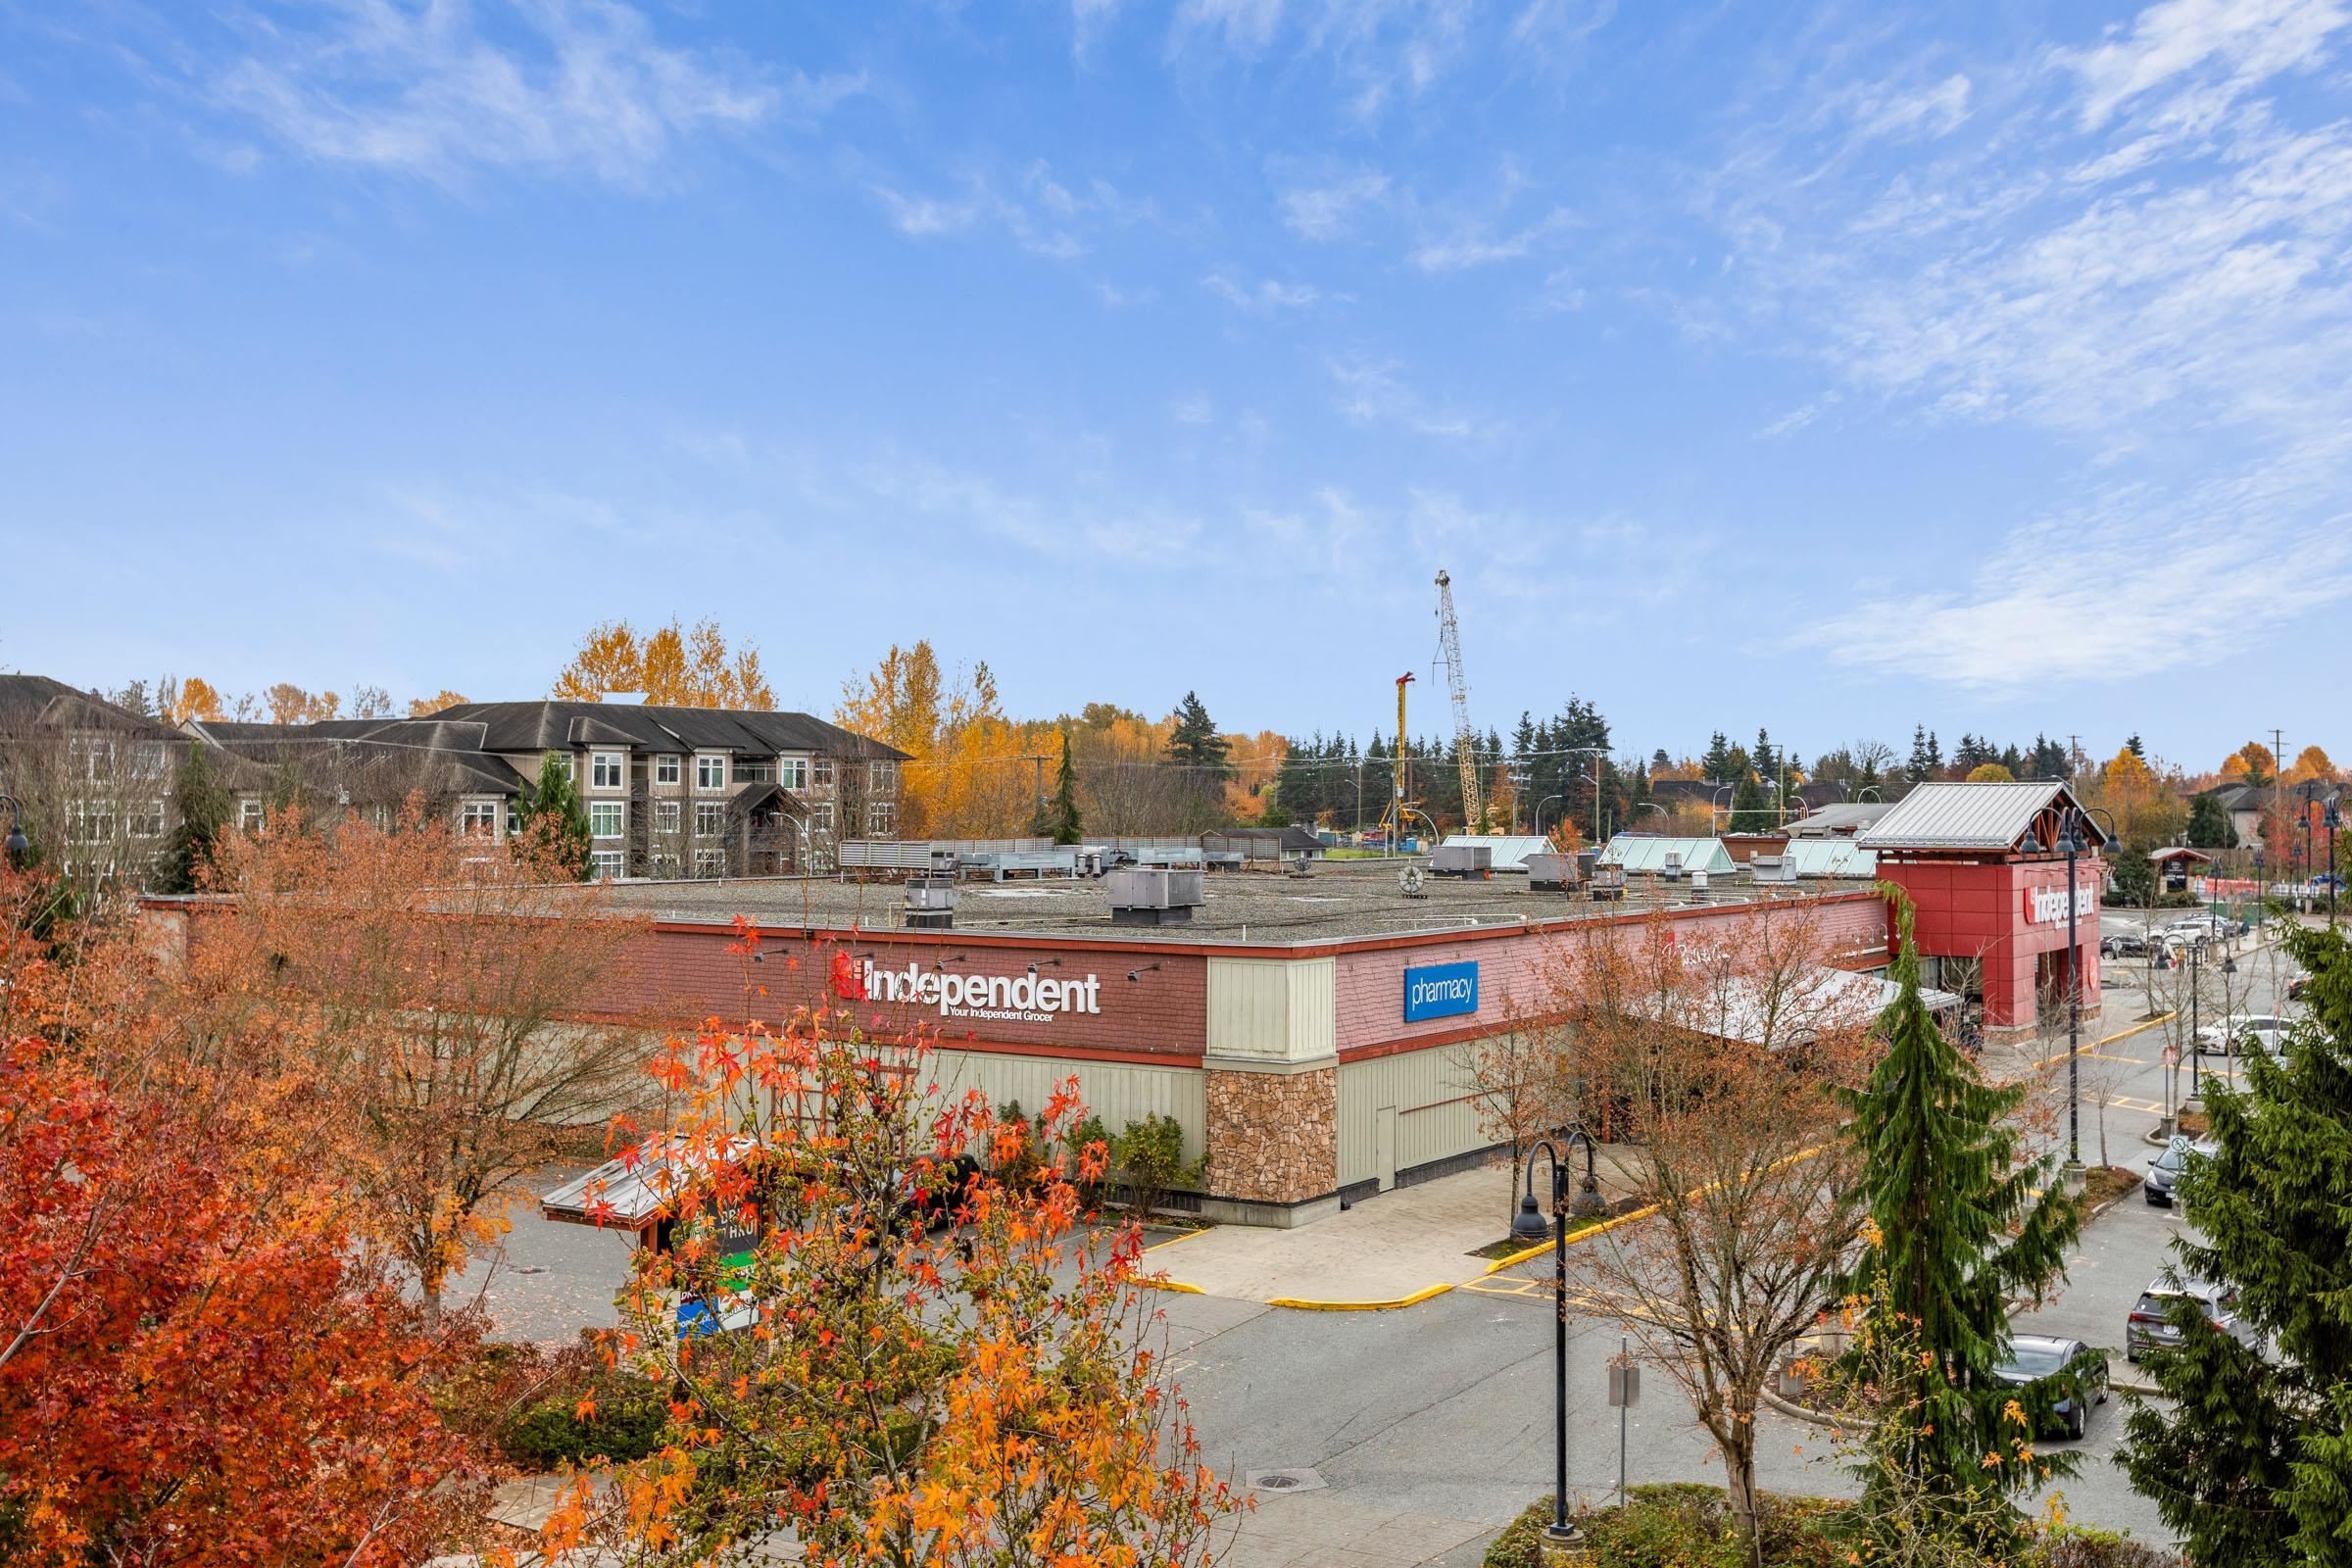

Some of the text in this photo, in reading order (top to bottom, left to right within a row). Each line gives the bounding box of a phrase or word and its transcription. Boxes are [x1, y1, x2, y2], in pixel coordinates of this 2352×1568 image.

[864, 960, 1101, 1015] Independent
[1412, 977, 1472, 1011] pharmacy
[950, 1006, 1054, 1022] Your Independent Grocer
